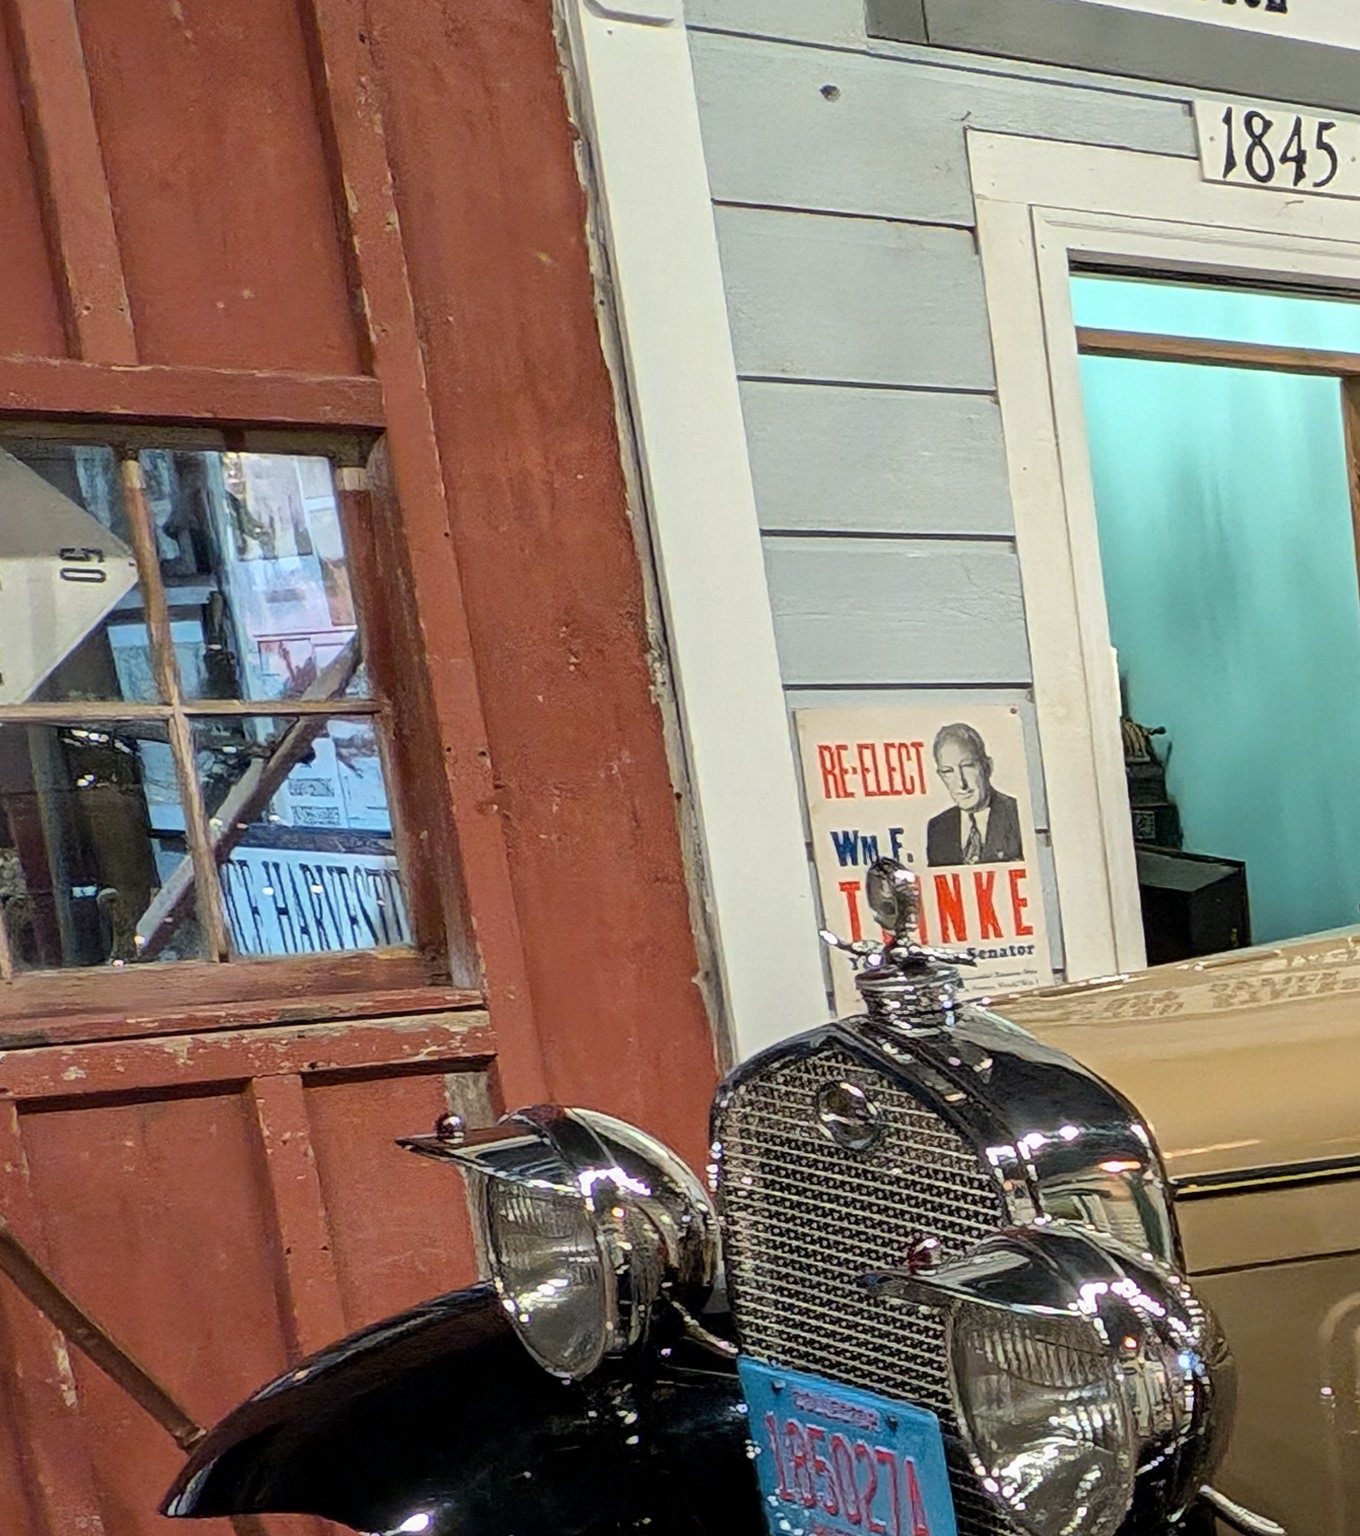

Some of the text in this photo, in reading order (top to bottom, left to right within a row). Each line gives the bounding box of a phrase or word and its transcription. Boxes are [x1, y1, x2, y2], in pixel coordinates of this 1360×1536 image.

[1221, 106, 1339, 188] 1845
[818, 741, 928, 799] RE-ELECT
[966, 943, 1035, 962] Senator
